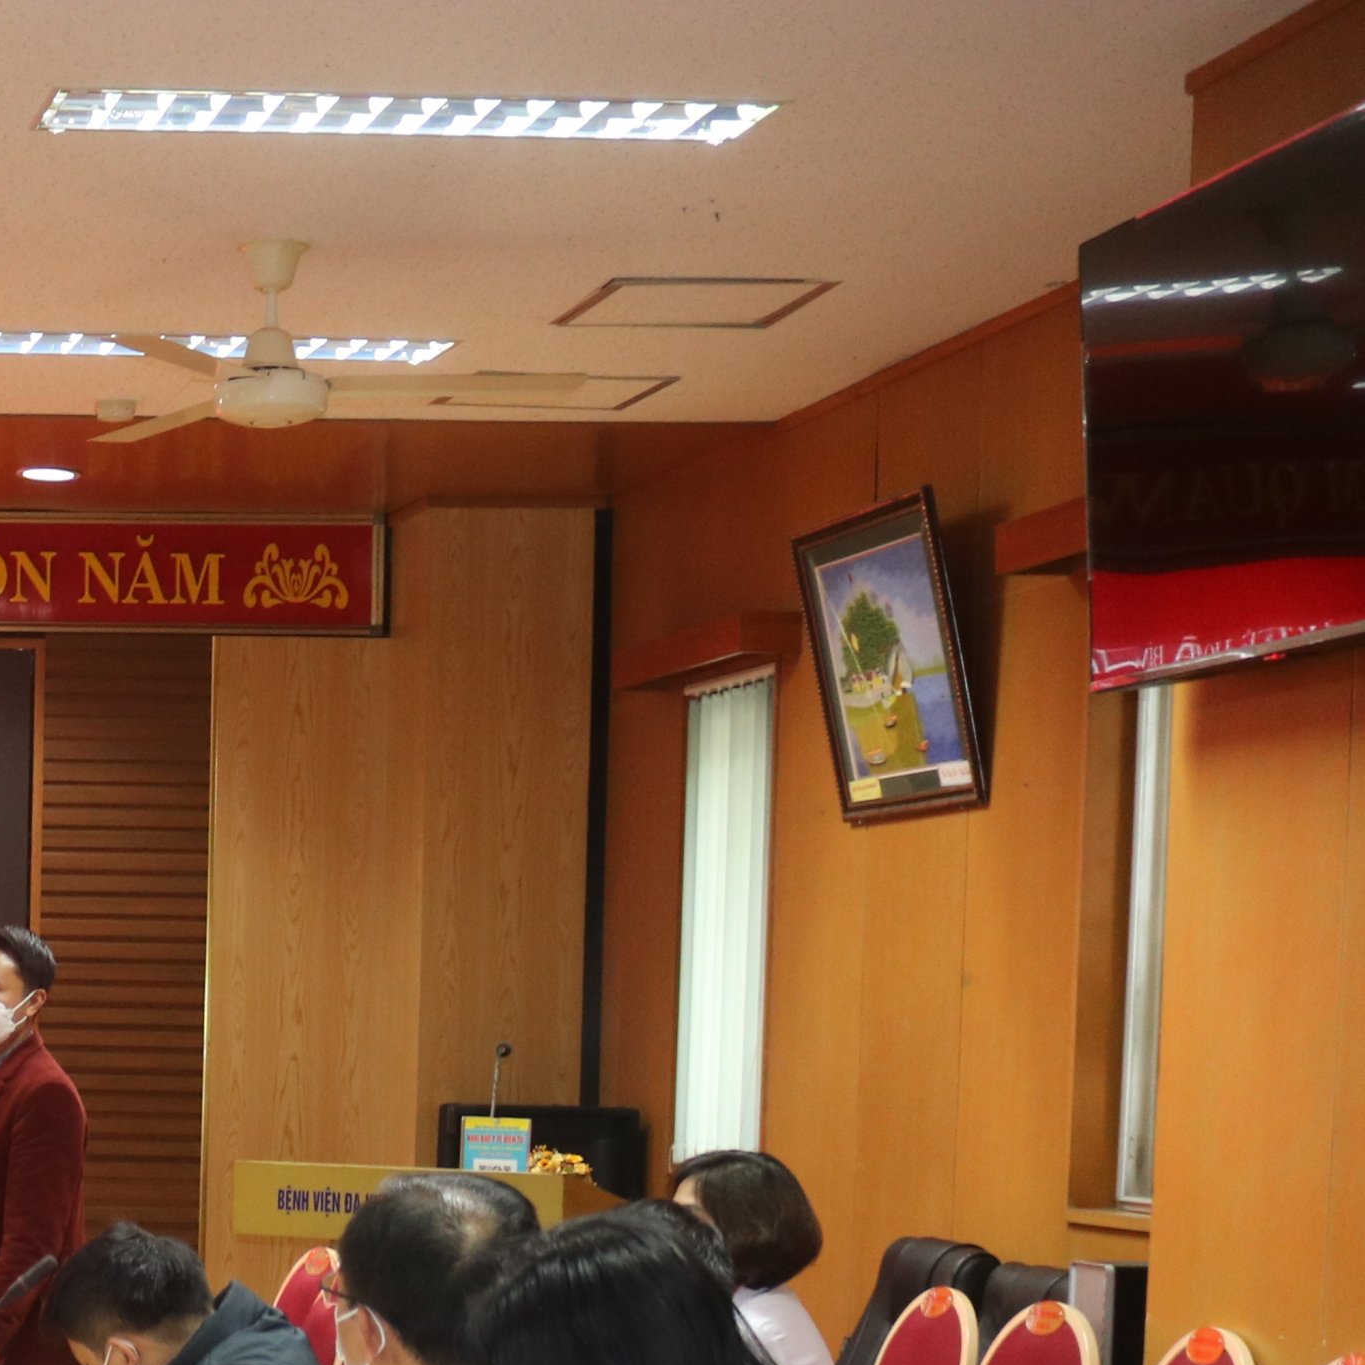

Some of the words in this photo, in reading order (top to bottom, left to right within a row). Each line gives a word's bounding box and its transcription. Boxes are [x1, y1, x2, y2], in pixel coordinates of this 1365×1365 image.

[78, 534, 226, 605] NĂM
[277, 1185, 309, 1216] BỆNH
[313, 1186, 341, 1217] VIỆN
